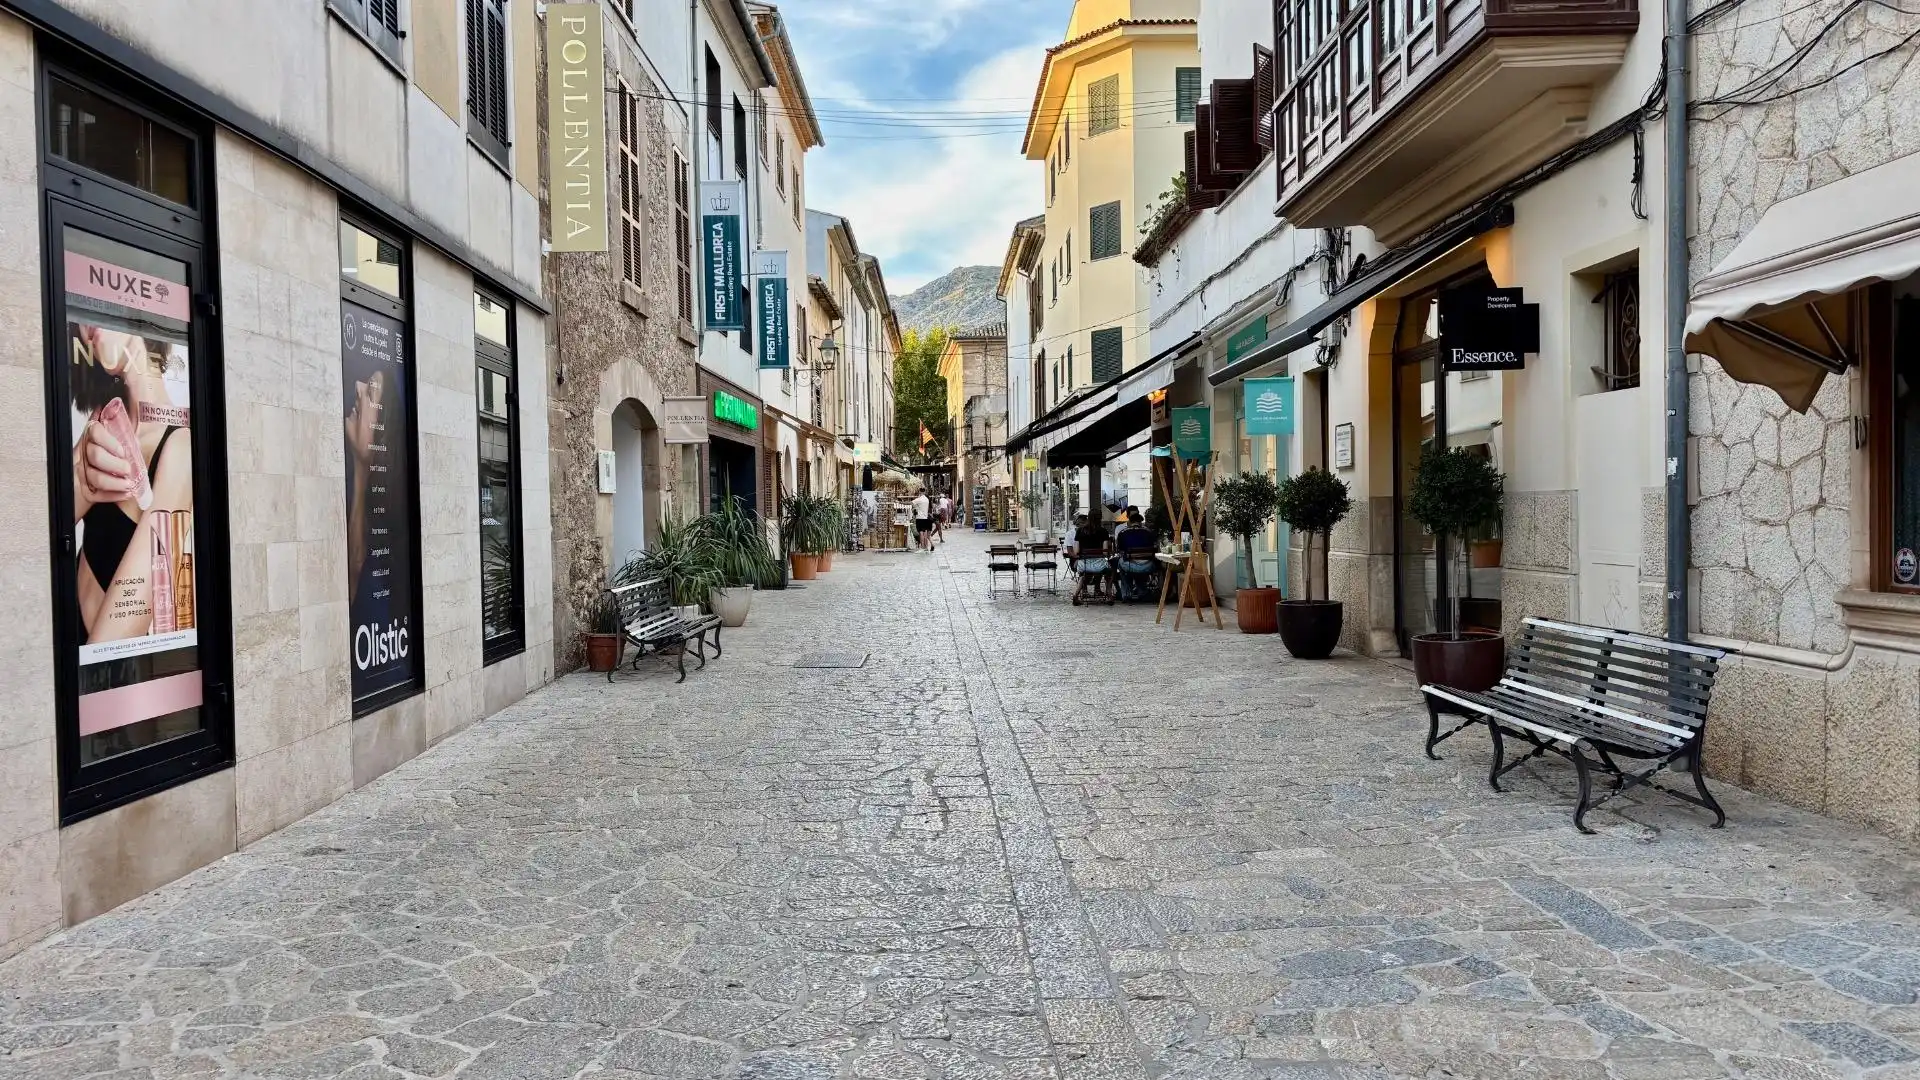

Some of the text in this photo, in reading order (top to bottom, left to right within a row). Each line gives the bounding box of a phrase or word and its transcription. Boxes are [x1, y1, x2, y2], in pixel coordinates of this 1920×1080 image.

[562, 15, 592, 241] POLLENTIA
[89, 264, 152, 300] NUXE
[712, 222, 726, 320] FIRST MALLORCA
[765, 283, 776, 361] FIRST MALLORCA
[1451, 348, 1518, 364] Essence.
[142, 405, 188, 419] INNOVACIÓN
[355, 617, 408, 671] Olistic
